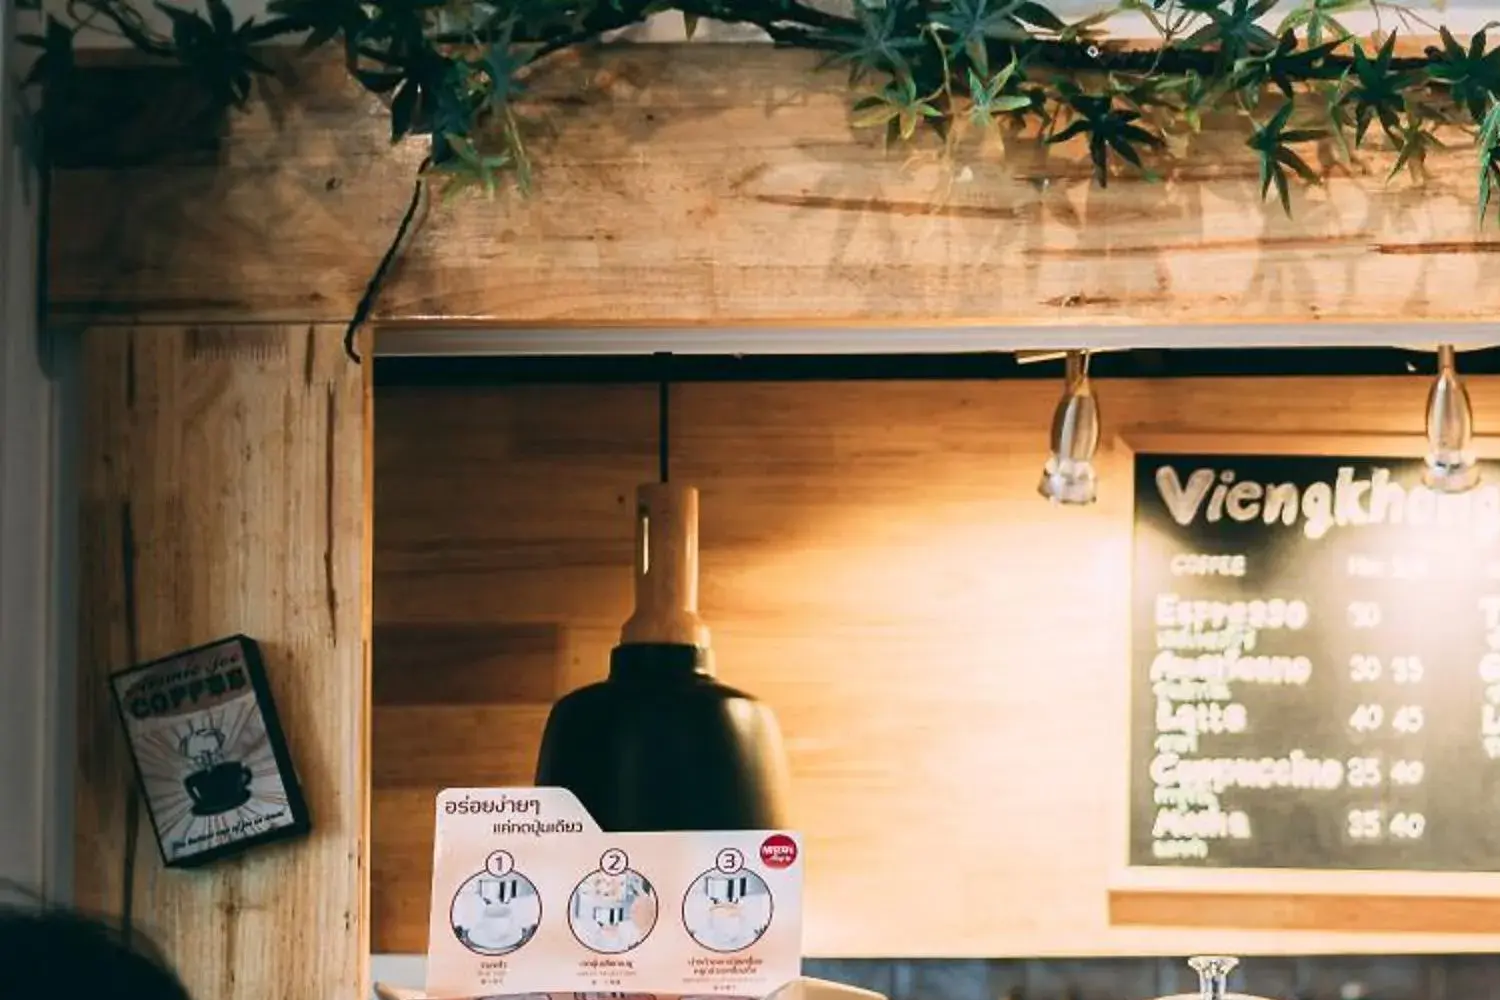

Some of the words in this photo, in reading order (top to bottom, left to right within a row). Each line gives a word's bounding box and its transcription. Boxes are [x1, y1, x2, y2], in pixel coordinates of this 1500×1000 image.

[1156, 594, 1308, 632] Espresso
[1349, 653, 1382, 683] 30
[1157, 700, 1247, 734] Latte
[1348, 703, 1385, 733] 40
[1150, 749, 1343, 791] Cappuccino
[1389, 758, 1425, 786] 40
[1346, 809, 1382, 839] 35
[1388, 810, 1426, 839] 40
[495, 856, 503, 871] 1
[607, 855, 620, 870] 2
[723, 854, 736, 869] 3
